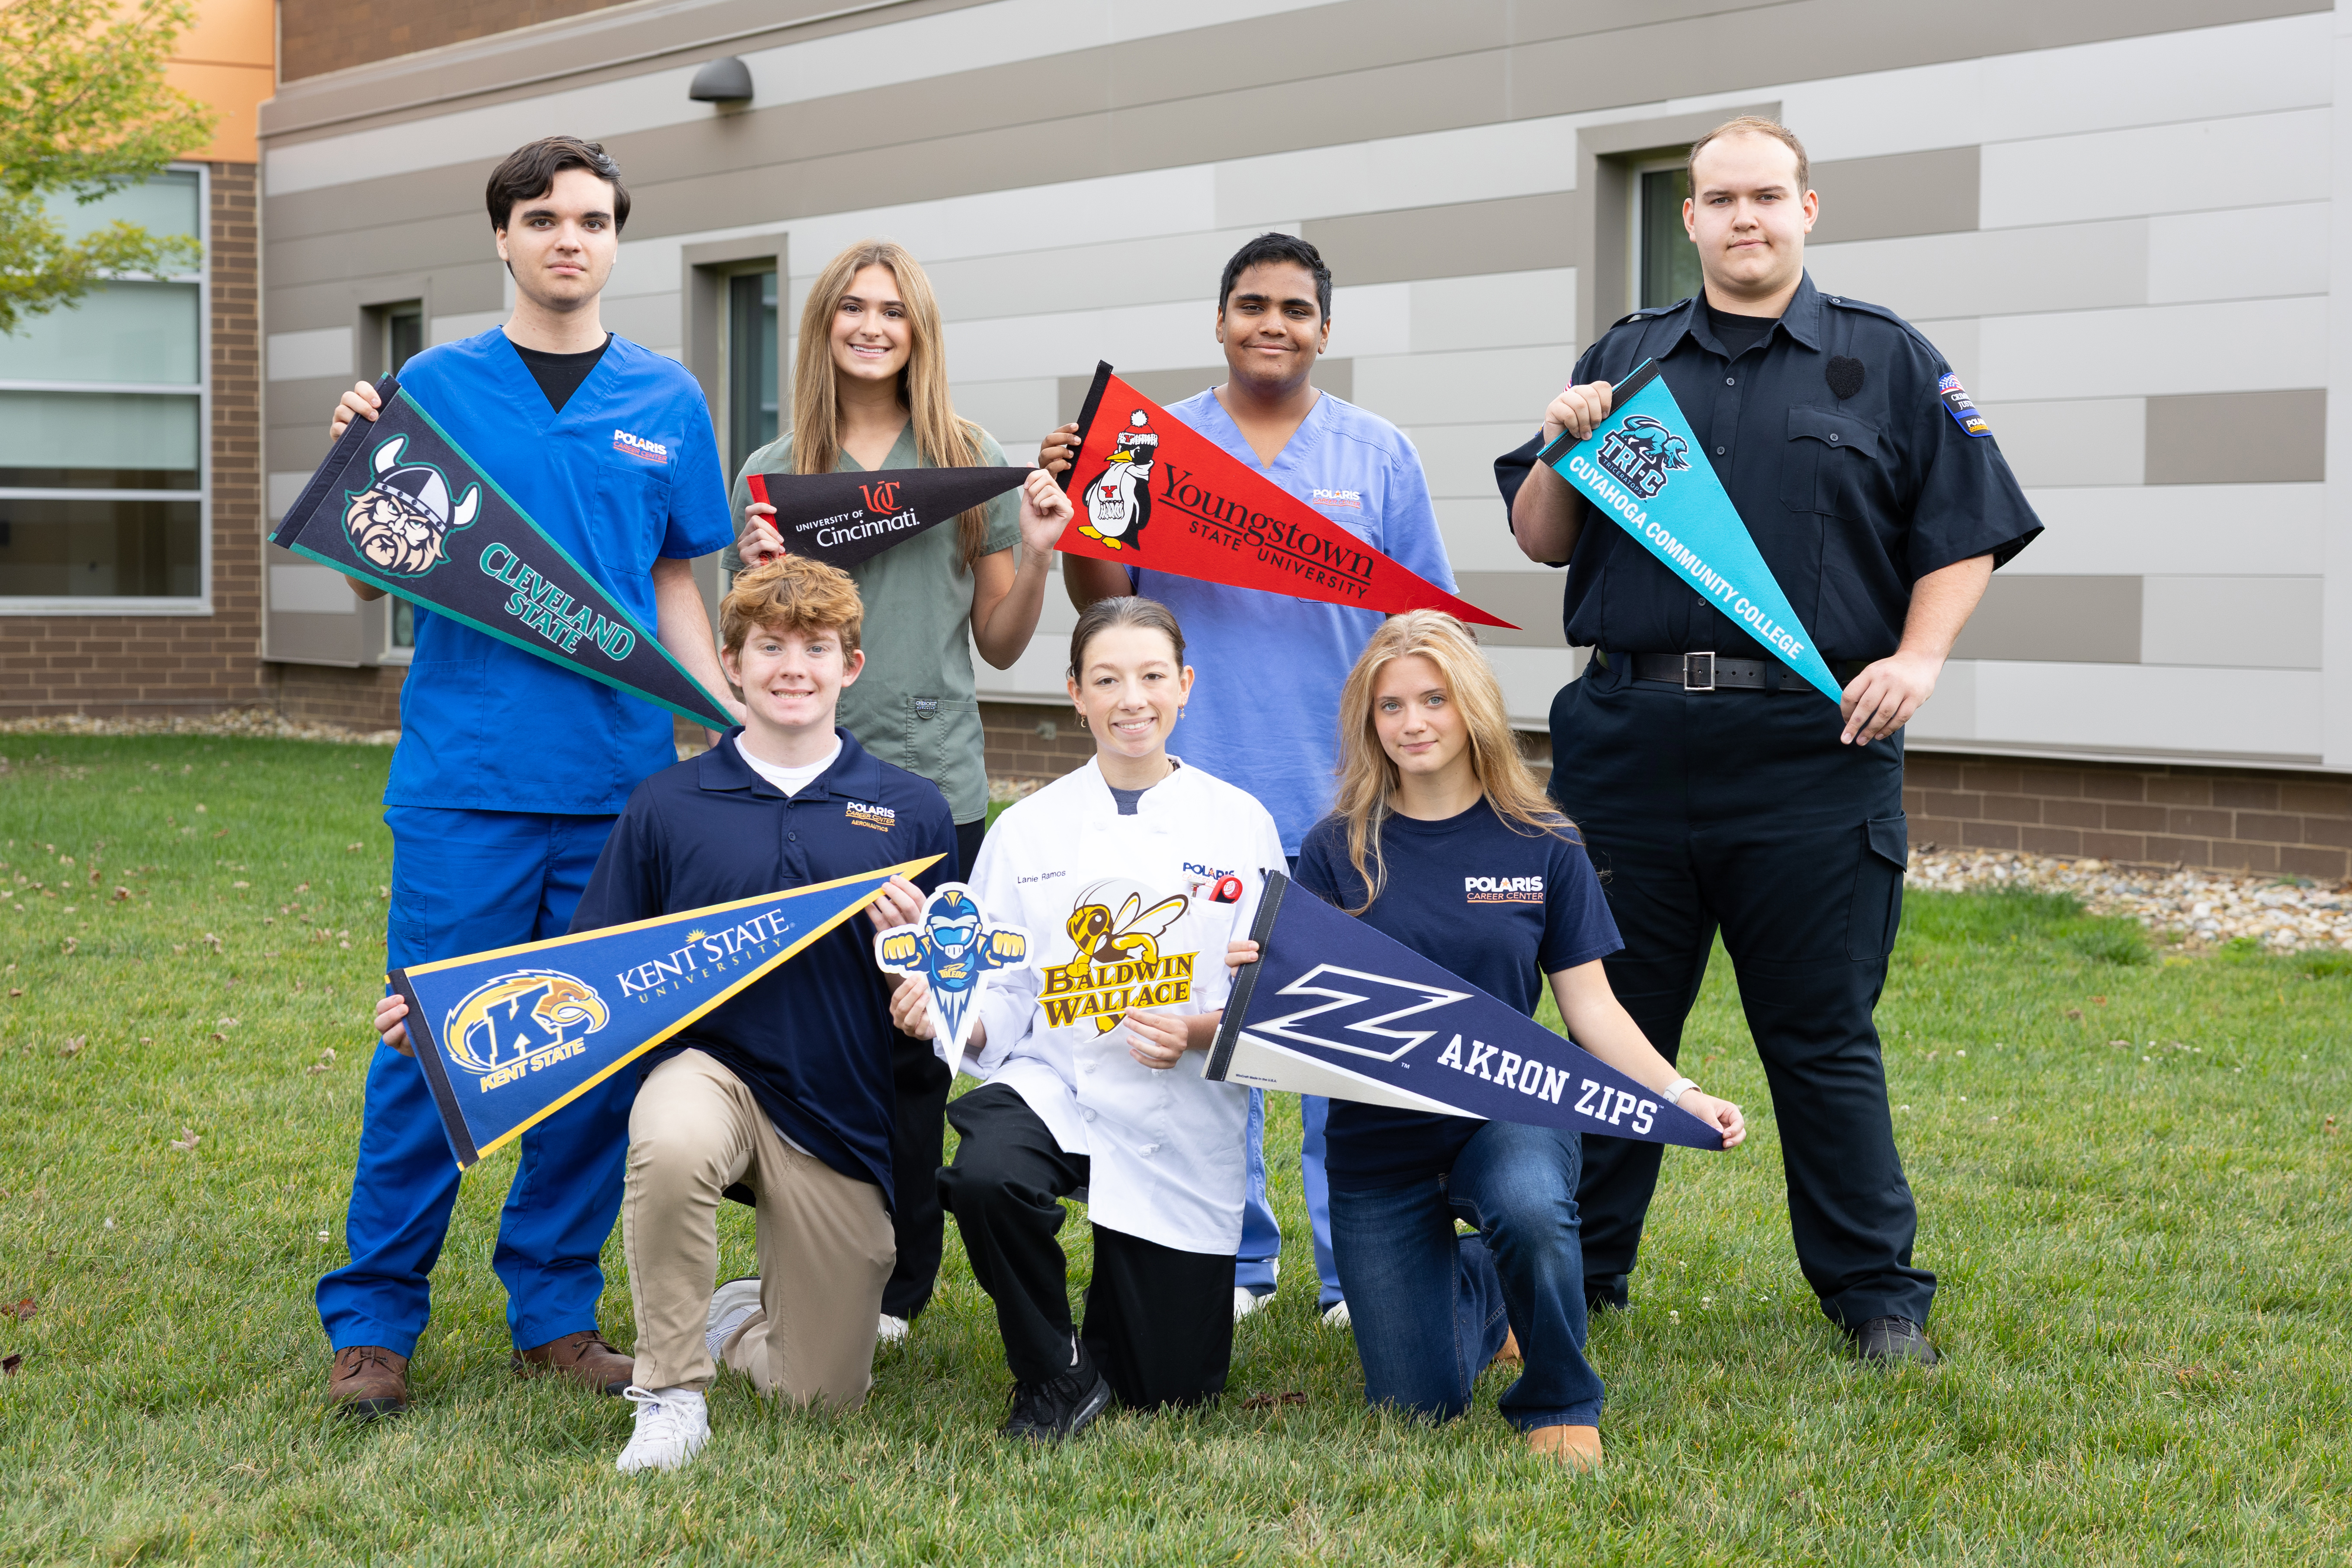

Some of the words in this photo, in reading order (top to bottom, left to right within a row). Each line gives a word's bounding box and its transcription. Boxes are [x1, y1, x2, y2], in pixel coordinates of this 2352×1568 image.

[613, 441, 640, 455] CAREER
[641, 451, 668, 461] CENTER
[614, 430, 667, 455] POLARIS
[1125, 435, 1134, 443] Y
[1603, 459, 1643, 495] TRICERATOPS
[1101, 485, 1118, 498] Y
[1313, 489, 1360, 501] POLARIS
[796, 513, 849, 532] UNIVERSITY
[852, 510, 864, 519] OF
[1161, 462, 1374, 580] Youngstown
[1189, 521, 1242, 552] STATE
[1257, 548, 1368, 600] UNIVERSITY
[1570, 456, 1647, 529] CUYAHOGA
[1646, 522, 1739, 603] COMMUNITY
[1734, 597, 1804, 660] COLLEGE
[480, 542, 636, 661] CLEVELAND
[504, 592, 583, 654] STATE
[846, 810, 871, 818] CAREER
[872, 814, 895, 824] CENTER
[847, 802, 895, 818] POLARIS
[851, 819, 888, 832] AERONAUTICS
[1017, 875, 1038, 884] Lanie
[1041, 870, 1066, 881] Ramos
[1465, 876, 1543, 892] POLARIS
[1506, 892, 1544, 900] CENTER
[615, 943, 698, 998] KENT
[702, 908, 789, 963] STATE
[638, 938, 782, 1004] UNIVERSITY
[938, 965, 967, 979] TOLEDO
[1041, 953, 1196, 996] BALDWIN
[1040, 979, 1190, 1026] WALLACE
[480, 1060, 528, 1093] KENT
[530, 1037, 586, 1072] STATE
[1437, 1033, 1570, 1104] AKRON
[1574, 1078, 1658, 1135] ZIPS
